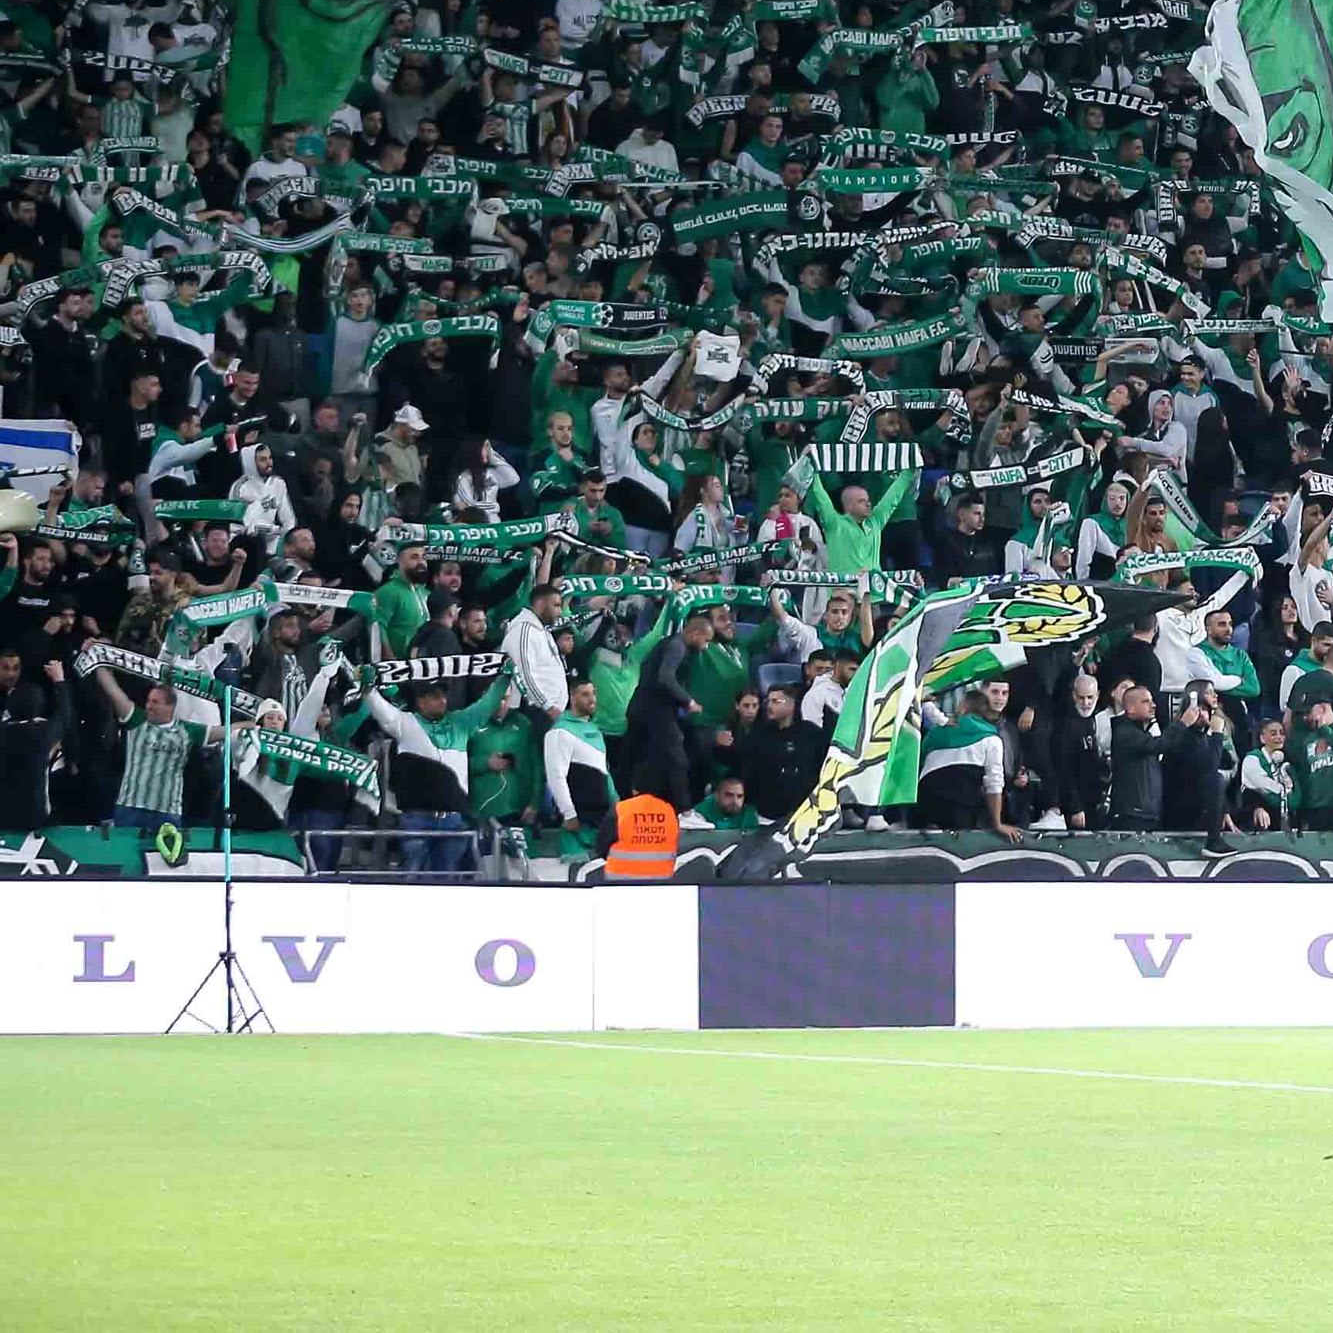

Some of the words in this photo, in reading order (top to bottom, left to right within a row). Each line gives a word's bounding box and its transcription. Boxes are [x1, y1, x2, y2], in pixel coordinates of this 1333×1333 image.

[904, 133, 946, 150] מכבי
[369, 176, 416, 192] חיפה
[427, 177, 472, 194] מכבי
[910, 239, 946, 259] חיפה
[950, 234, 981, 250] מכבי
[839, 332, 892, 352] MACCABI
[892, 325, 931, 345] HAIFA
[1050, 342, 1096, 357] JUVENTUS
[753, 400, 804, 417] עולה
[989, 466, 1022, 485] HAIFA
[1045, 454, 1073, 473] CITY
[457, 526, 498, 539] חיפה
[505, 522, 543, 536] מכבי
[661, 553, 716, 571] MACCABI
[719, 545, 759, 559] HAIFA
[186, 599, 229, 621] MACCABI
[376, 653, 504, 684] 2002
[633, 813, 666, 824] סדרן
